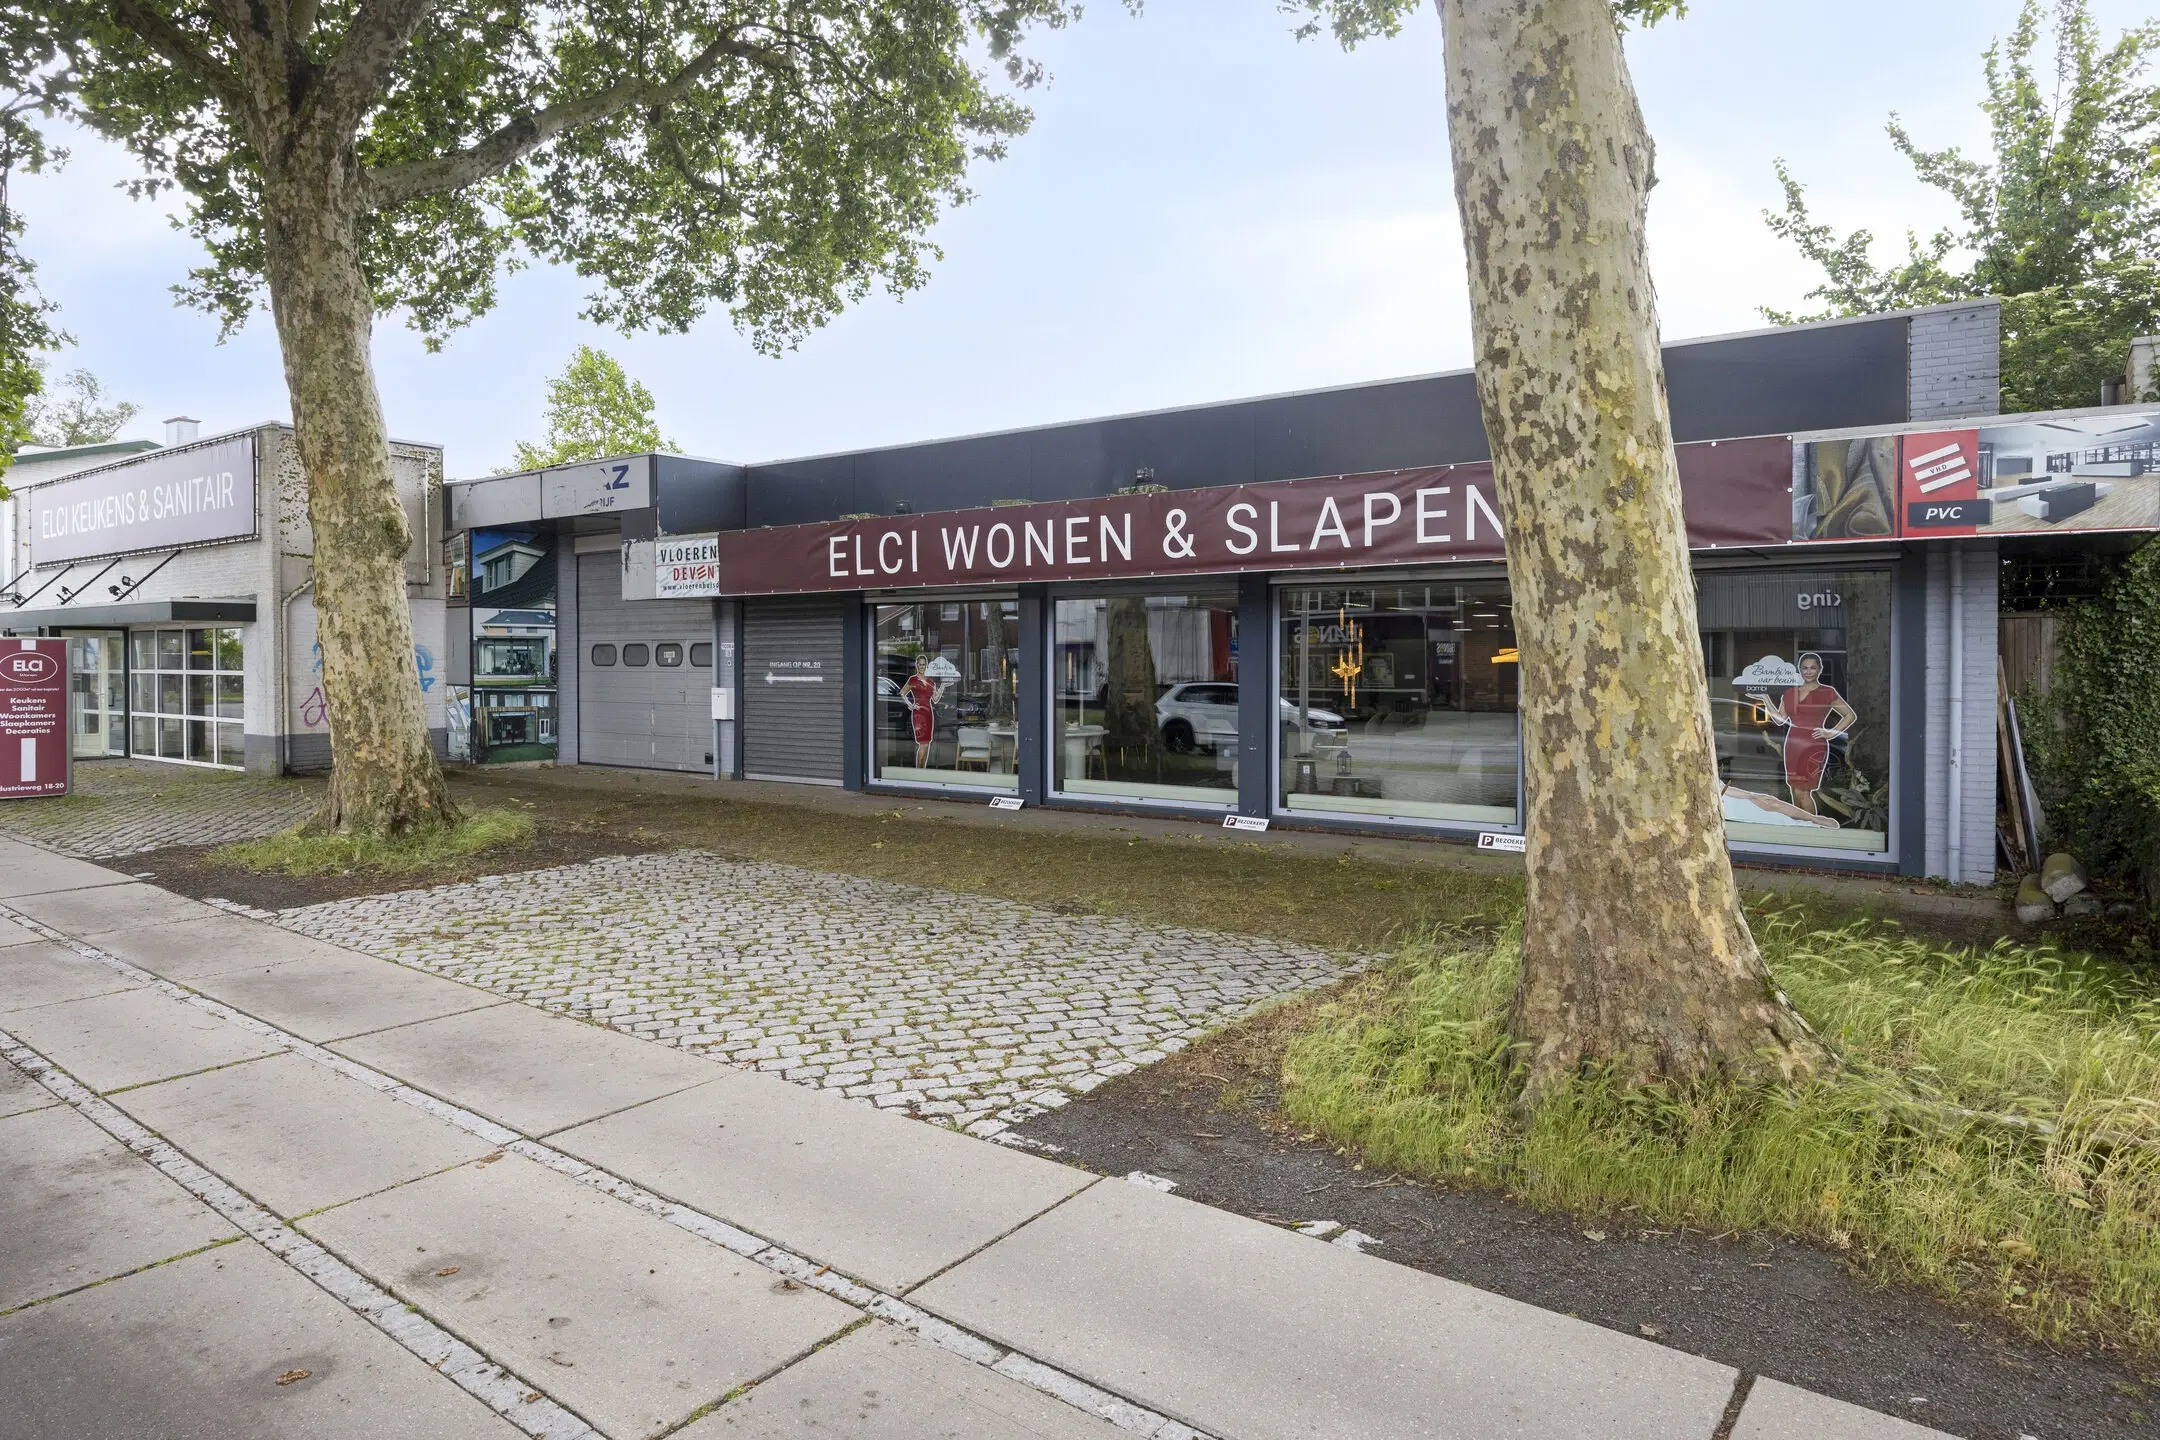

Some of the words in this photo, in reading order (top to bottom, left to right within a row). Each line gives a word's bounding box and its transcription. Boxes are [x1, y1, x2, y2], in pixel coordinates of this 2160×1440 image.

[1930, 464, 1947, 474] VHD
[41, 505, 69, 539] ELCI
[71, 492, 135, 535] KEUKENS
[139, 489, 150, 521] &
[153, 472, 235, 520] SANITAIR
[1925, 506, 1963, 520] PVC
[829, 530, 918, 577] ELCI
[941, 513, 1132, 571] WONEN
[1162, 508, 1197, 559] &
[1225, 484, 1505, 555] SLAPEN
[660, 545, 717, 563] VLOEREN
[673, 565, 718, 581] DEVEN
[13, 660, 43, 672] ELCI
[0, 719, 56, 728] Slaapkamers
[6, 727, 50, 735] Decoraties
